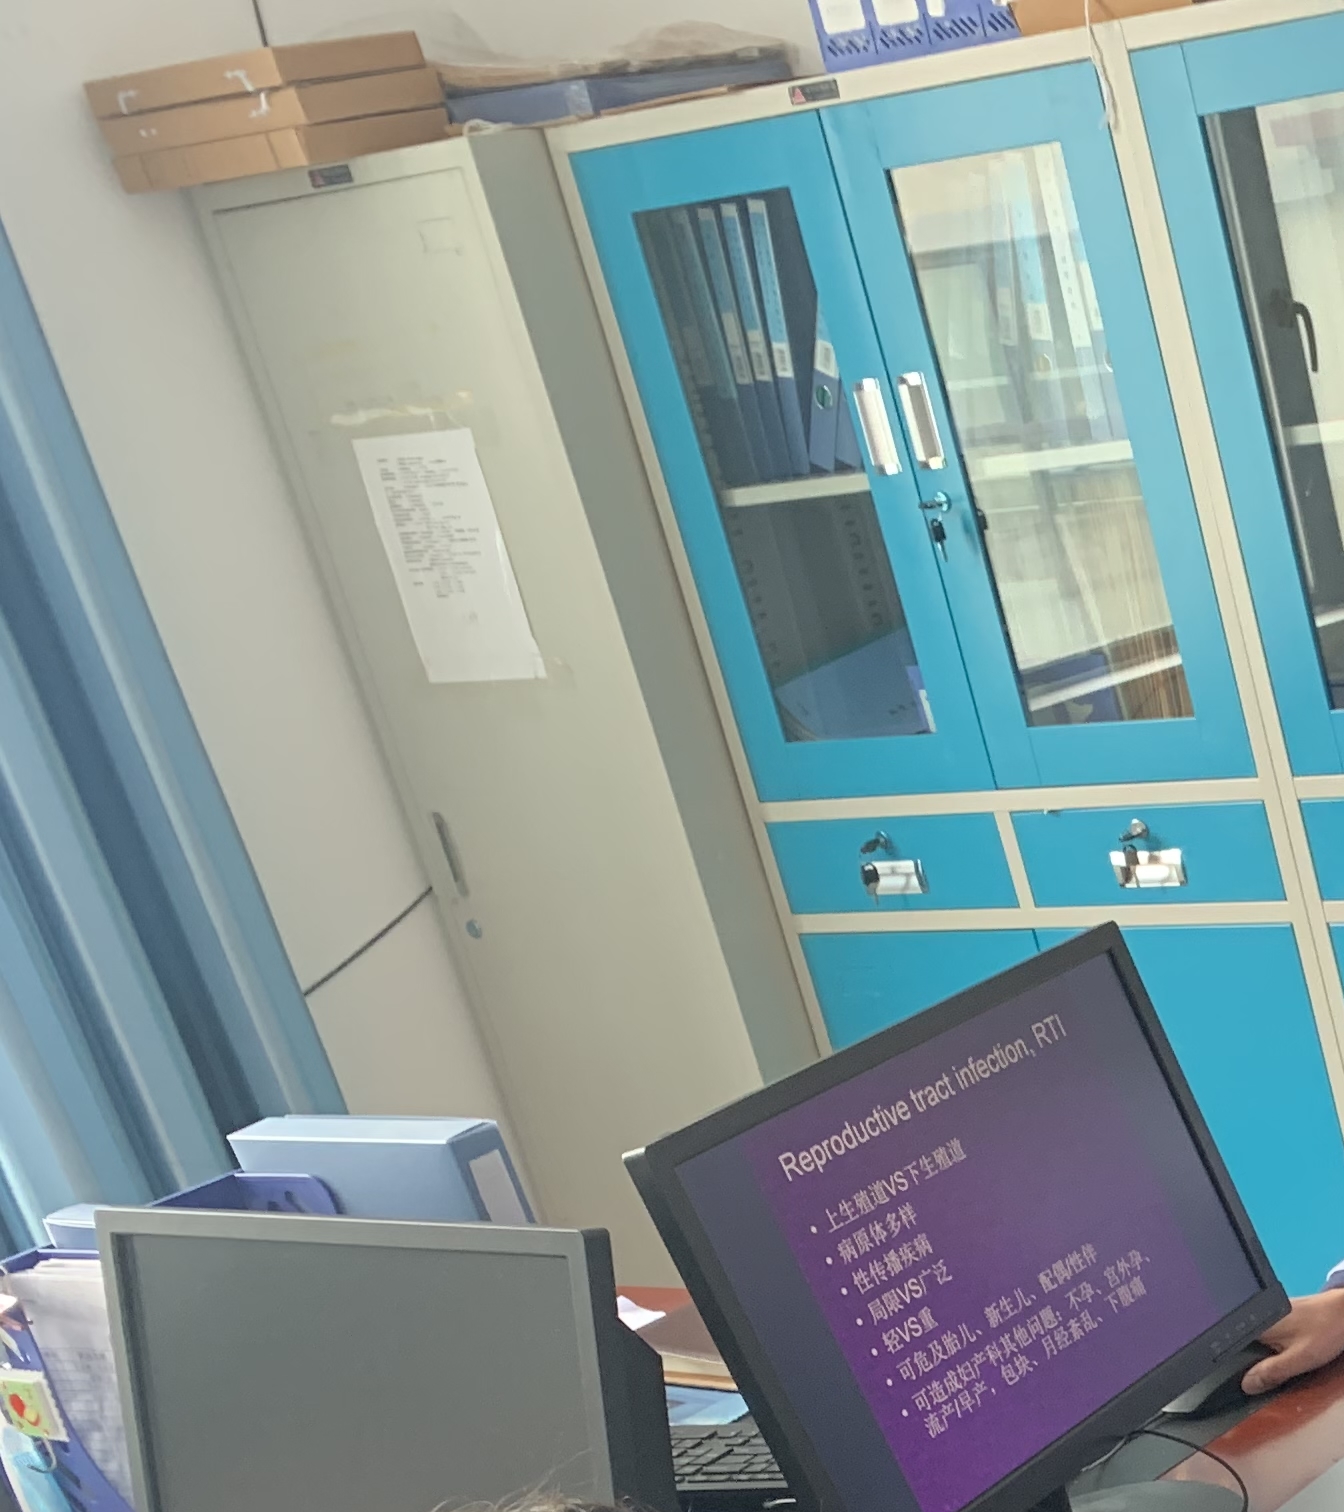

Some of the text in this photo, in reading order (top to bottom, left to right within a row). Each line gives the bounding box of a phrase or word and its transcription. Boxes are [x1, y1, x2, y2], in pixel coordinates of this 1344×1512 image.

[778, 1013, 1067, 1182] Reproductive tract infection, RTI
[825, 1137, 967, 1233] 上生殖道VS下生殖道
[837, 1201, 917, 1265] 病原体多样
[852, 1233, 933, 1295] 性传播疾病
[867, 1259, 953, 1326] 局限VS广泛
[881, 1305, 939, 1354] 轻VS重
